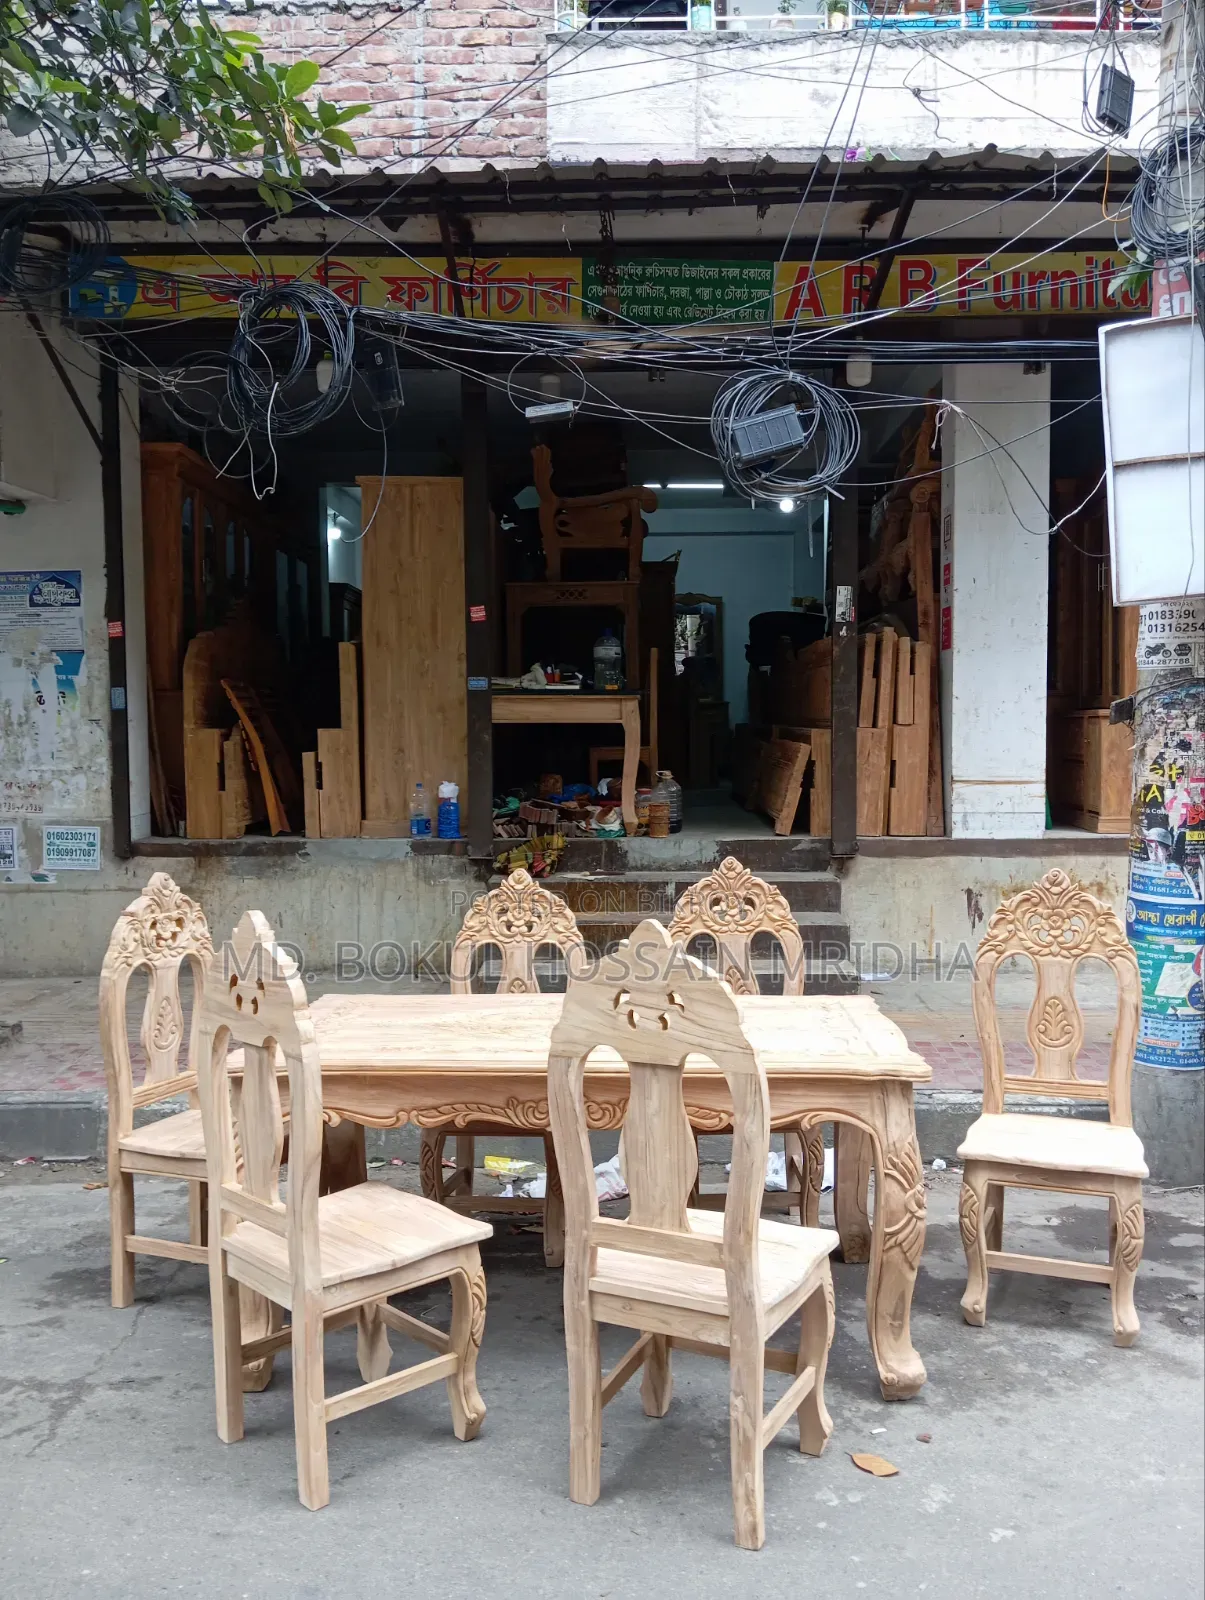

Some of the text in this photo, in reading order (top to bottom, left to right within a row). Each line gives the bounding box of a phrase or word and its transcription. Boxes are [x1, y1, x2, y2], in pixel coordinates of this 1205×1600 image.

[721, 267, 741, 280] সকল
[742, 267, 772, 281] প্রকারের
[781, 261, 830, 322] A
[901, 258, 939, 313] B
[666, 306, 681, 318] এবং
[46, 831, 97, 841] 01602303171
[46, 847, 97, 857] 01909917087
